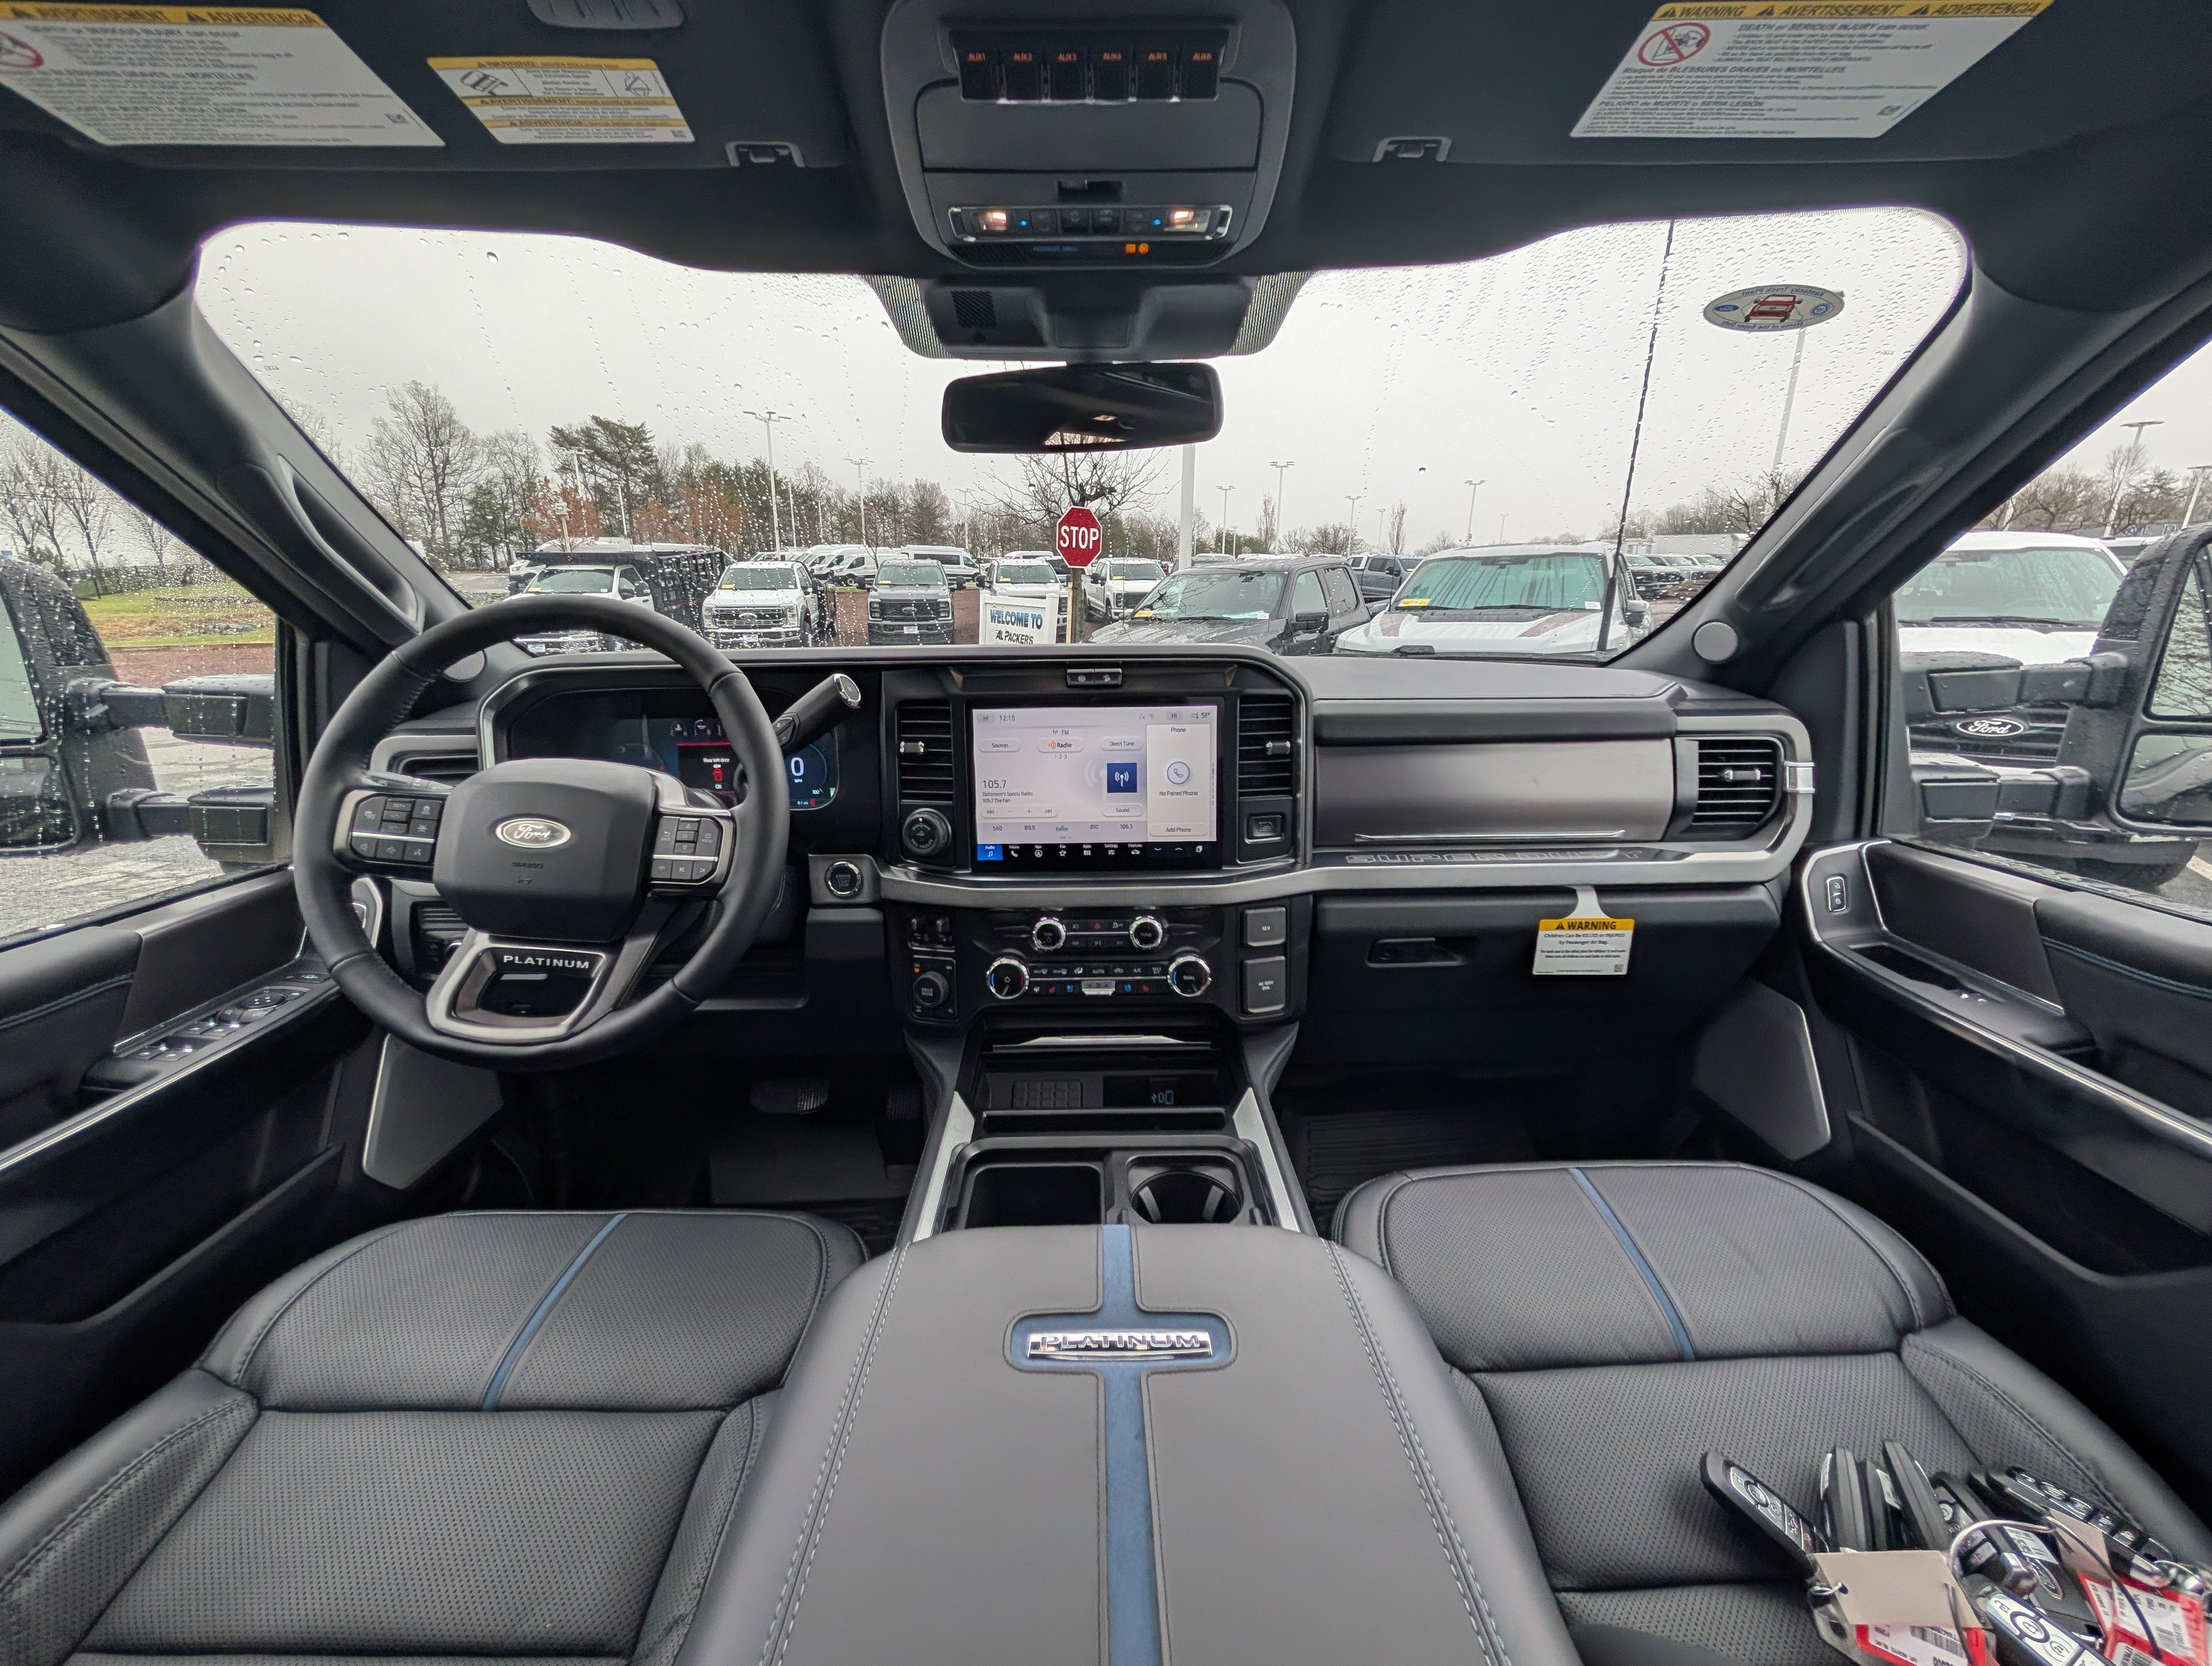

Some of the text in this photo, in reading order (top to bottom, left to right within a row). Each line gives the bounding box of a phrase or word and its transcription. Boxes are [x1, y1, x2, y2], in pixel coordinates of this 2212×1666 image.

[1679, 2, 2043, 18] WARNING AVERTISSEMENT ADVERTENCIA
[1060, 525, 1099, 549] STOP
[989, 609, 1043, 630] WELCOME TO
[995, 629, 1004, 640] AL
[1968, 719, 2011, 734] Ford
[791, 757, 804, 777] 0
[982, 780, 1007, 789] 105.7
[513, 823, 551, 840] Ford
[1345, 852, 1508, 864] SUPER
[1567, 921, 1617, 930] WARNING
[503, 955, 589, 969] PLATINUM
[1040, 1334, 1200, 1349] PLATINUM
